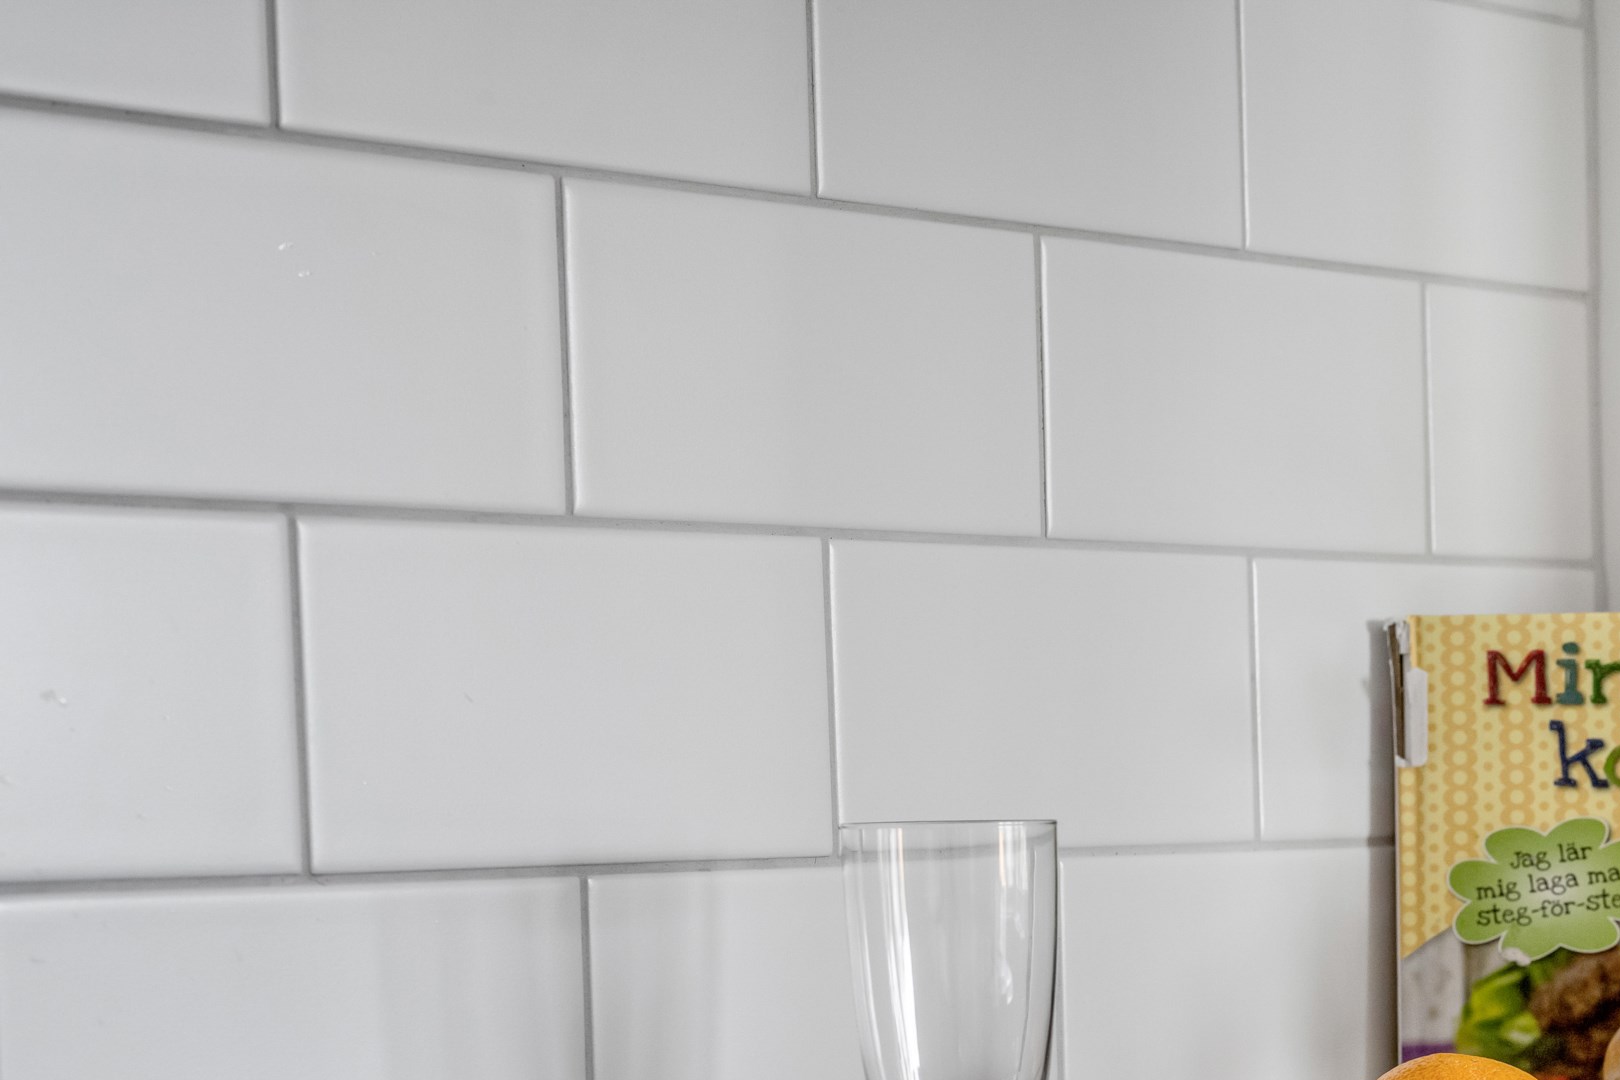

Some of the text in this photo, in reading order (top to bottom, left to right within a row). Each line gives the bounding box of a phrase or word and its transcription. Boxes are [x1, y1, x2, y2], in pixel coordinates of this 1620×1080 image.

[1510, 843, 1593, 871] Jag lär
[1476, 878, 1521, 901] mig
[1528, 872, 1579, 895] laga
